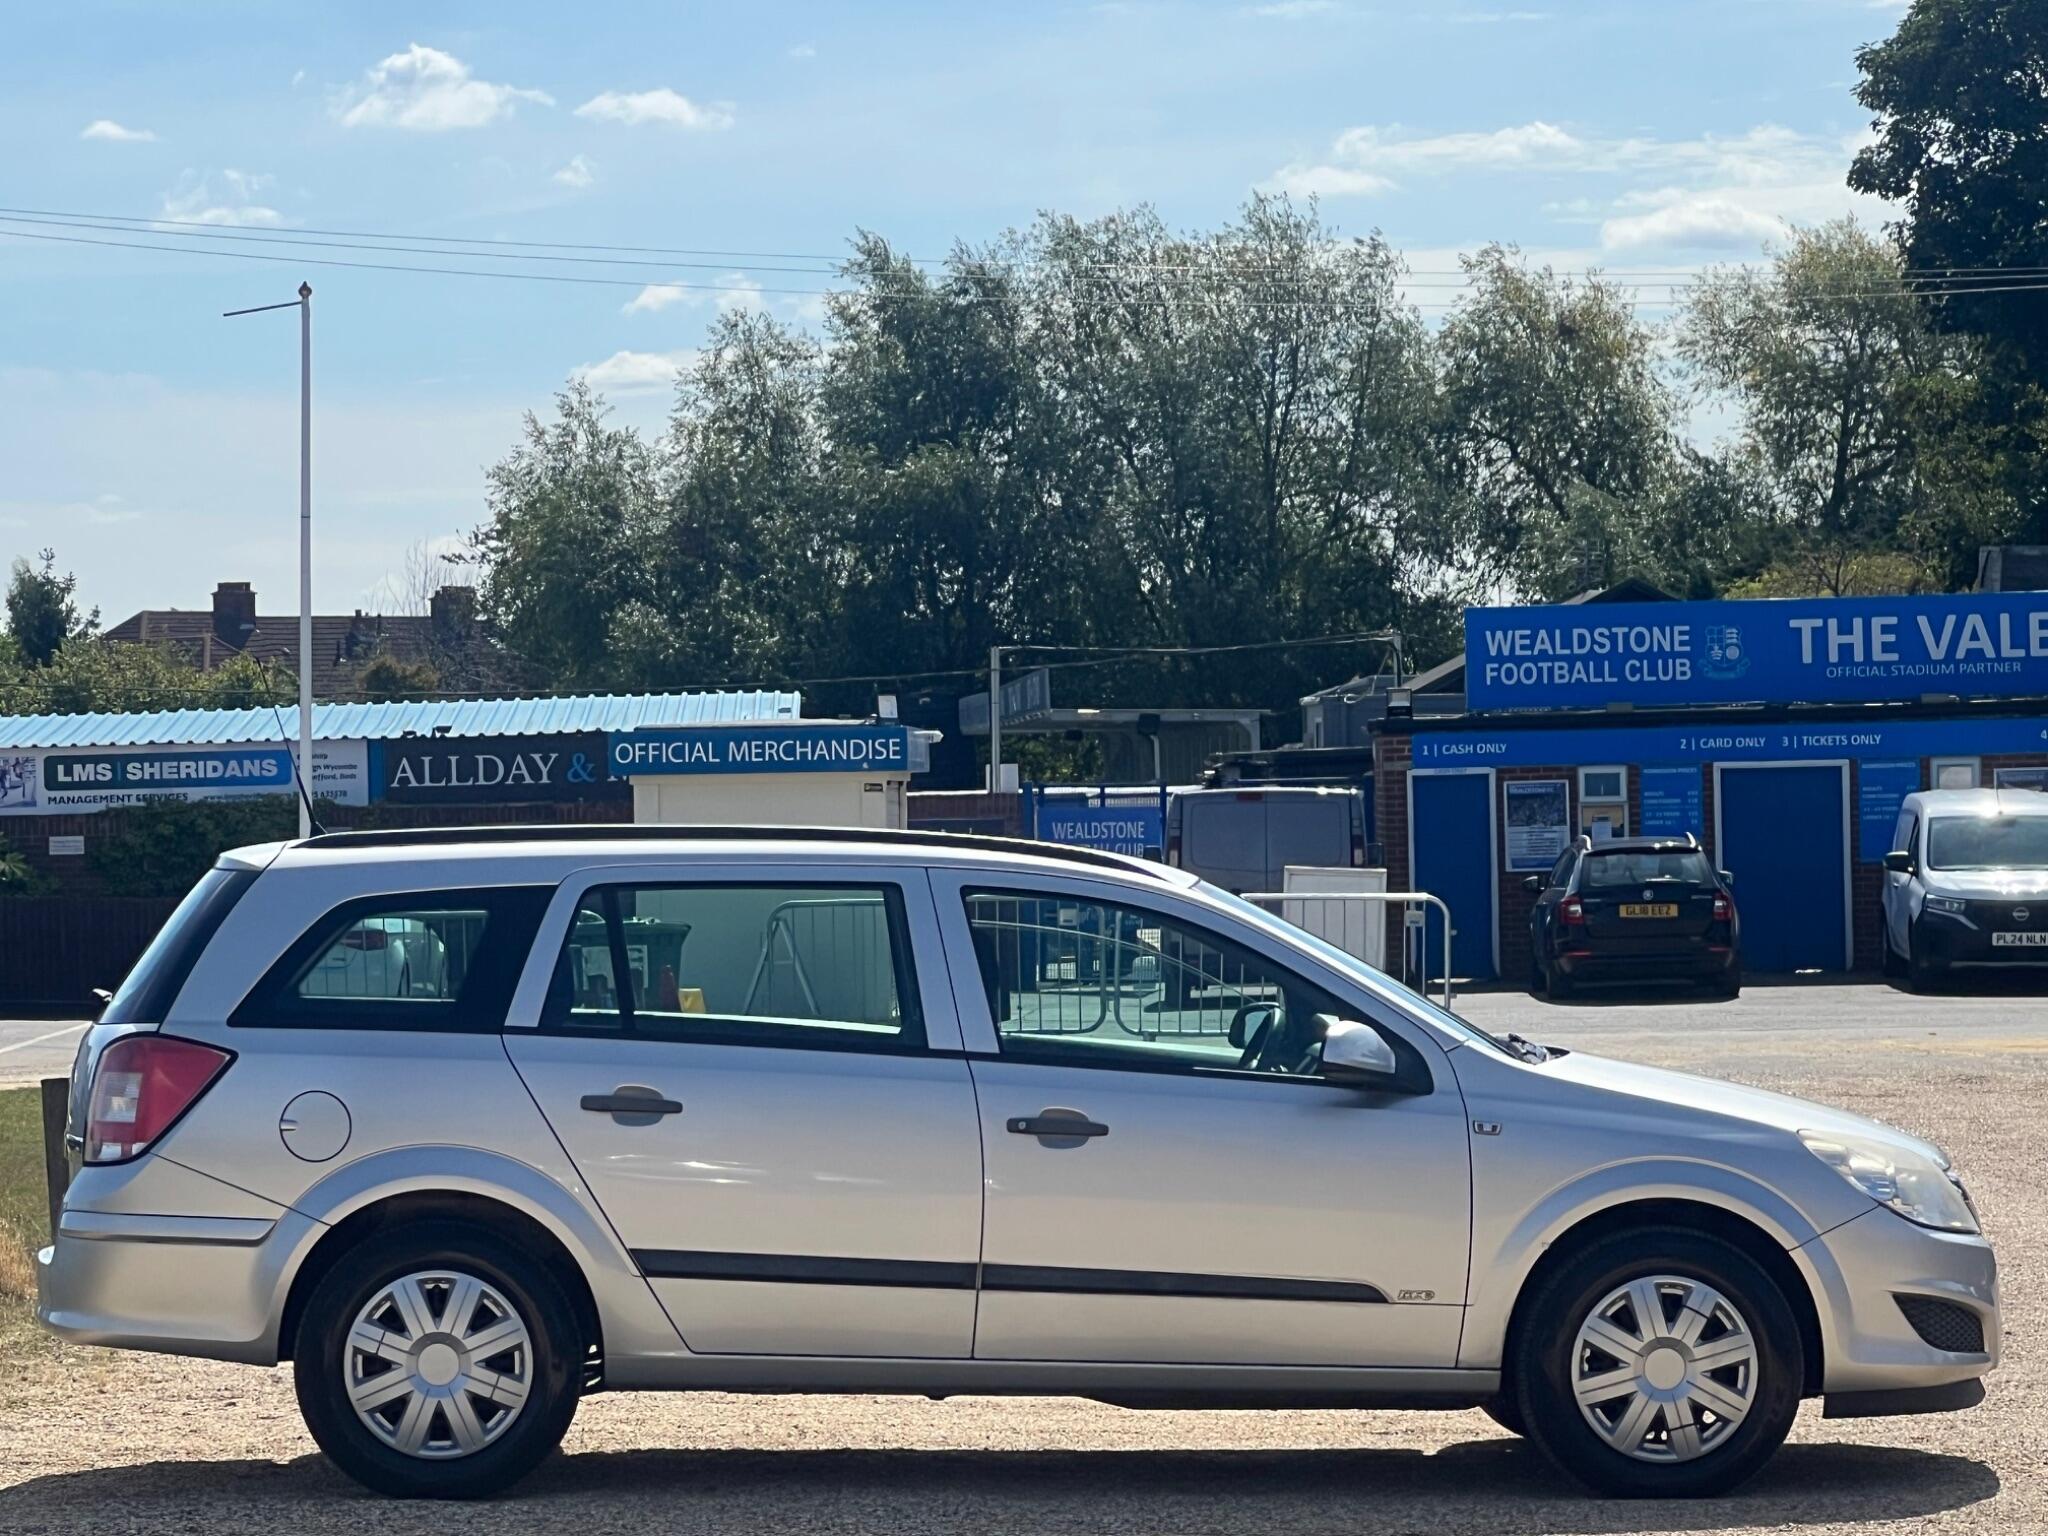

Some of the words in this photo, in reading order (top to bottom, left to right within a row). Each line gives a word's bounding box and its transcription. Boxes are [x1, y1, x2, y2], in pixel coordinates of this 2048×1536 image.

[1485, 625, 1692, 656] WEALDSTONE
[1789, 615, 1899, 664] THE
[1916, 611, 2048, 660] VALE
[1485, 660, 1618, 685] FOOTBALL
[1624, 658, 1692, 682] CLUB
[1826, 664, 1887, 678] OFFICIAL
[1891, 663, 1955, 676] STADIUM
[1959, 661, 2022, 674] PARTNER
[1422, 745, 1429, 755] 1
[1442, 744, 1474, 755] CASH
[1476, 743, 1507, 754] ONLY
[1680, 738, 1687, 749] 2
[1700, 737, 1733, 749] CARD
[1735, 737, 1766, 748] ONLY
[1781, 736, 1789, 747] 3
[1802, 735, 1848, 746] TICKETS
[1851, 734, 1881, 745] ONLY
[615, 741, 720, 764] OFFICIAL
[728, 738, 902, 762] MERCHANDISE
[57, 763, 113, 781] LMS
[126, 758, 278, 780] SHERIDANS
[390, 753, 559, 787] ALLDAY
[567, 752, 597, 783] &
[48, 793, 133, 805] MANAGEMENT
[135, 792, 189, 803] SERVICES
[1052, 821, 1145, 839] WEALDSTONE
[1996, 933, 2023, 944] PL24
[2026, 933, 2047, 944] NLN
